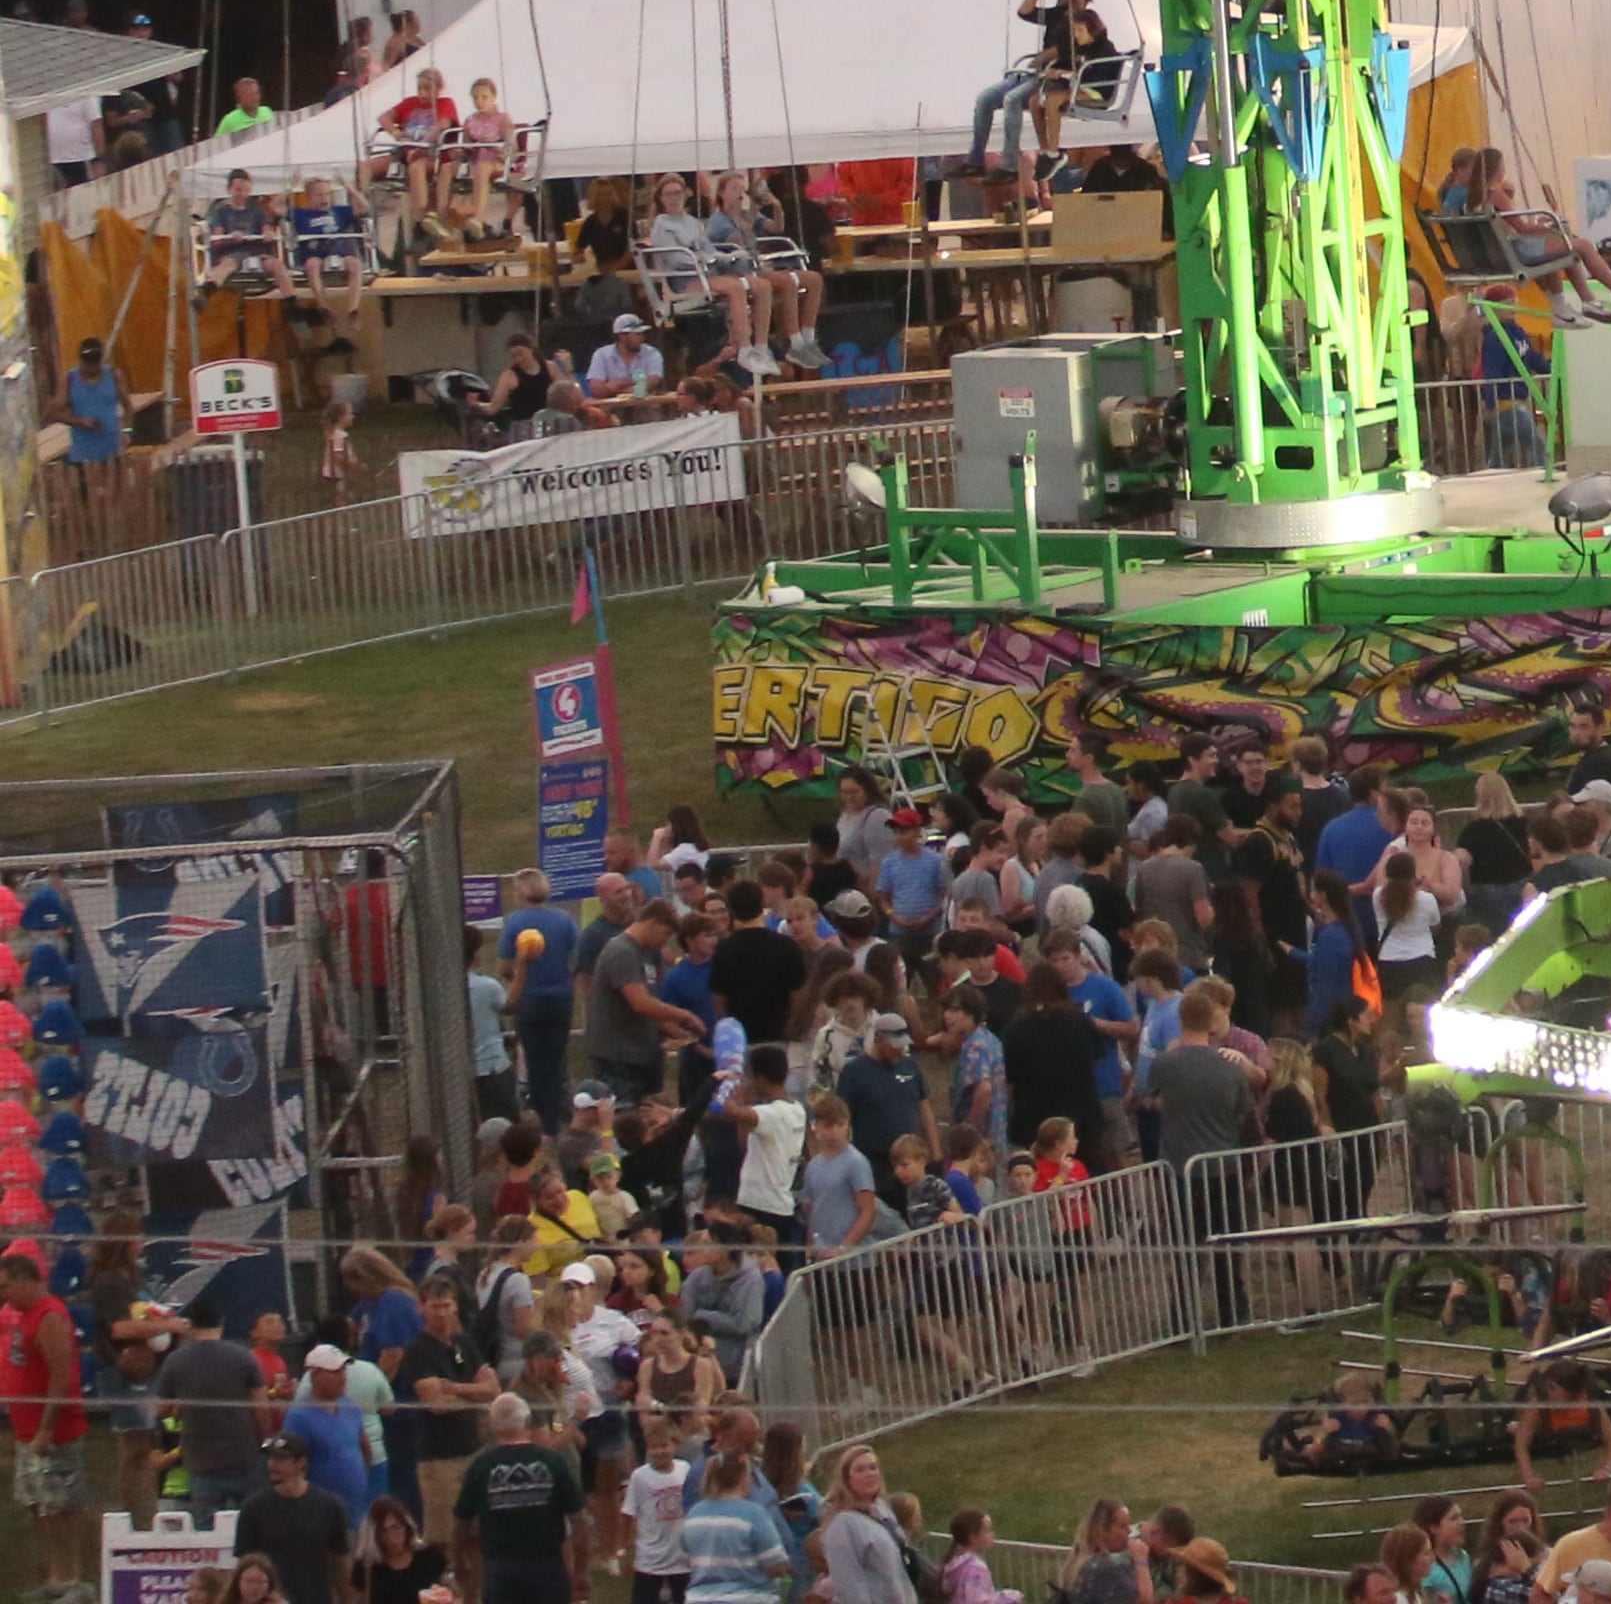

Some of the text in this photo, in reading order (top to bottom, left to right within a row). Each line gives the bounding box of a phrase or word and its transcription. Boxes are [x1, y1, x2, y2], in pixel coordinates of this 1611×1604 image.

[200, 396, 273, 413] BECK'S
[512, 461, 653, 496] Welcomes
[662, 447, 722, 478] You!
[558, 686, 577, 717] 4
[713, 664, 1039, 766] ERTIGO
[140, 1575, 190, 1591] PLEA
